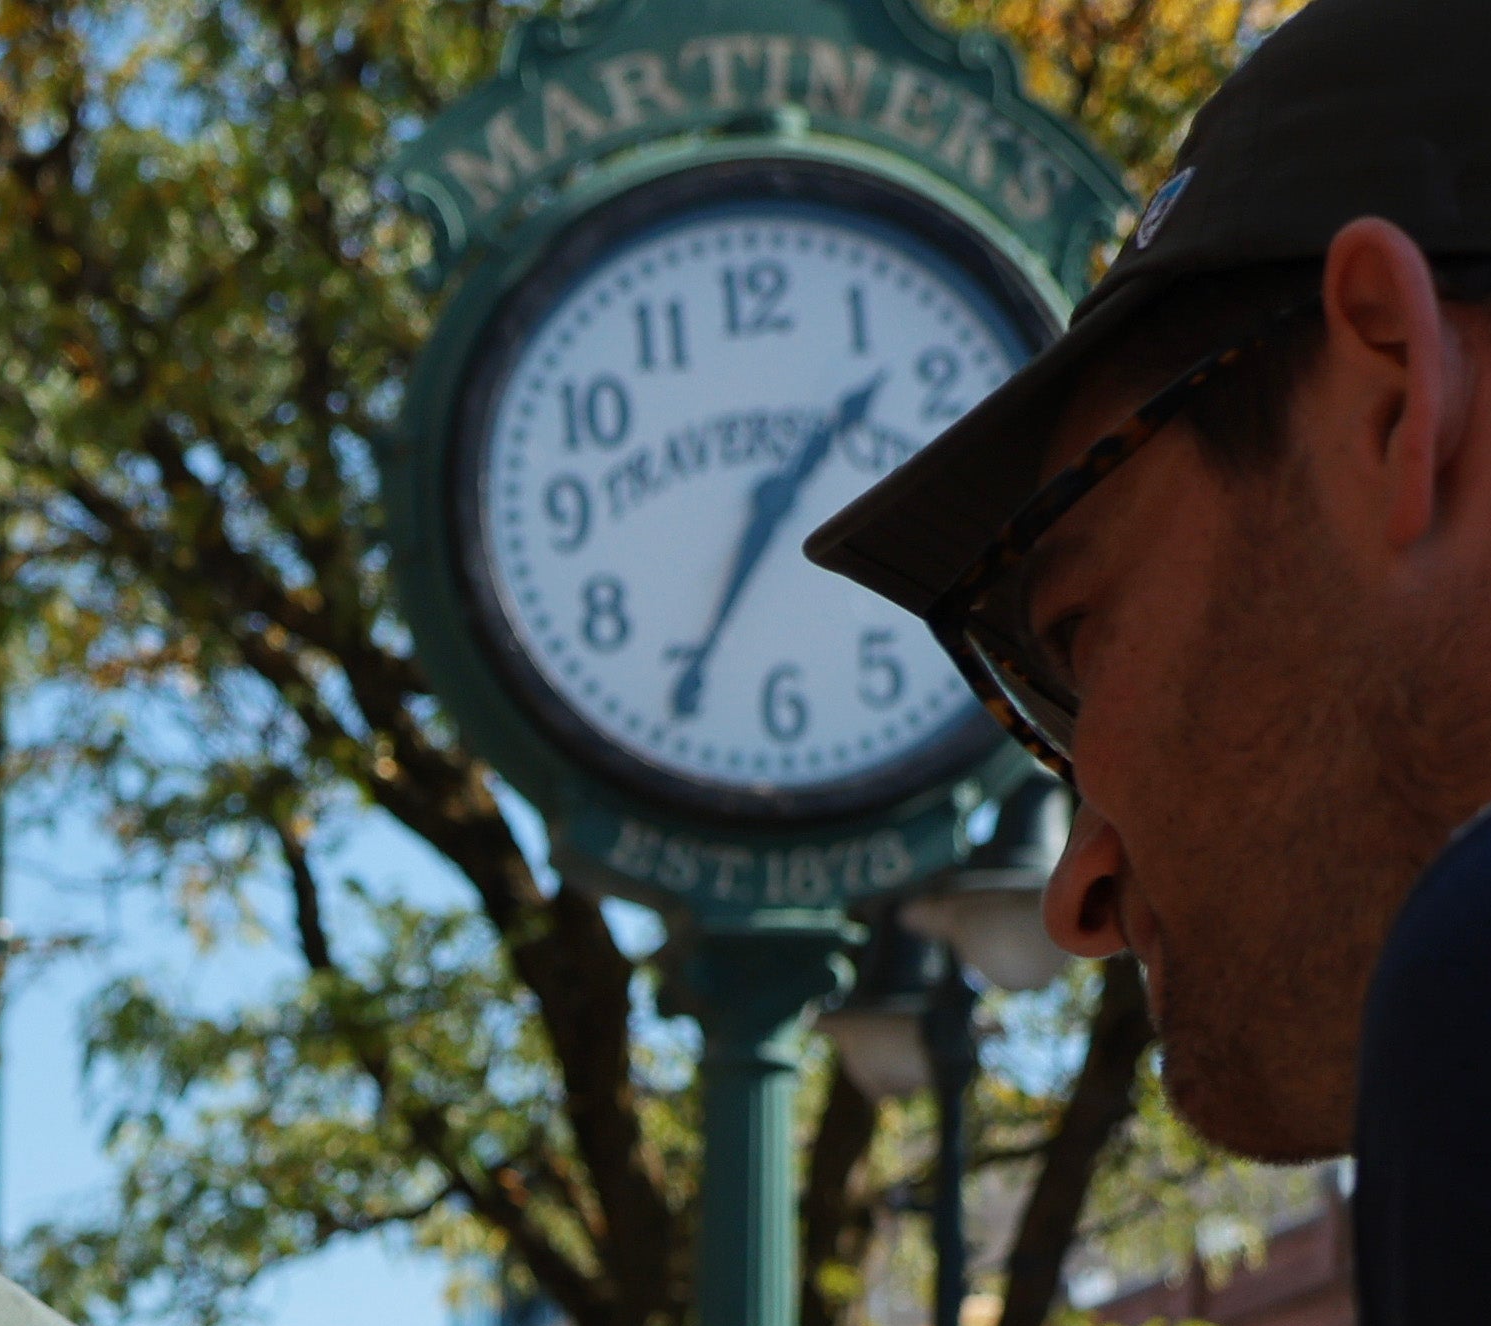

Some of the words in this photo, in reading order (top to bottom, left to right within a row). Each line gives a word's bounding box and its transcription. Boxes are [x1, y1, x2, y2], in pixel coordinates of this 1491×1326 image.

[634, 301, 688, 371] 11
[719, 259, 794, 337] 12
[846, 285, 871, 354] 1
[559, 374, 631, 452] 10
[916, 346, 975, 421] 2
[543, 475, 591, 552] 9
[580, 578, 630, 653] 8
[760, 664, 811, 744] 6
[857, 628, 907, 708] 5
